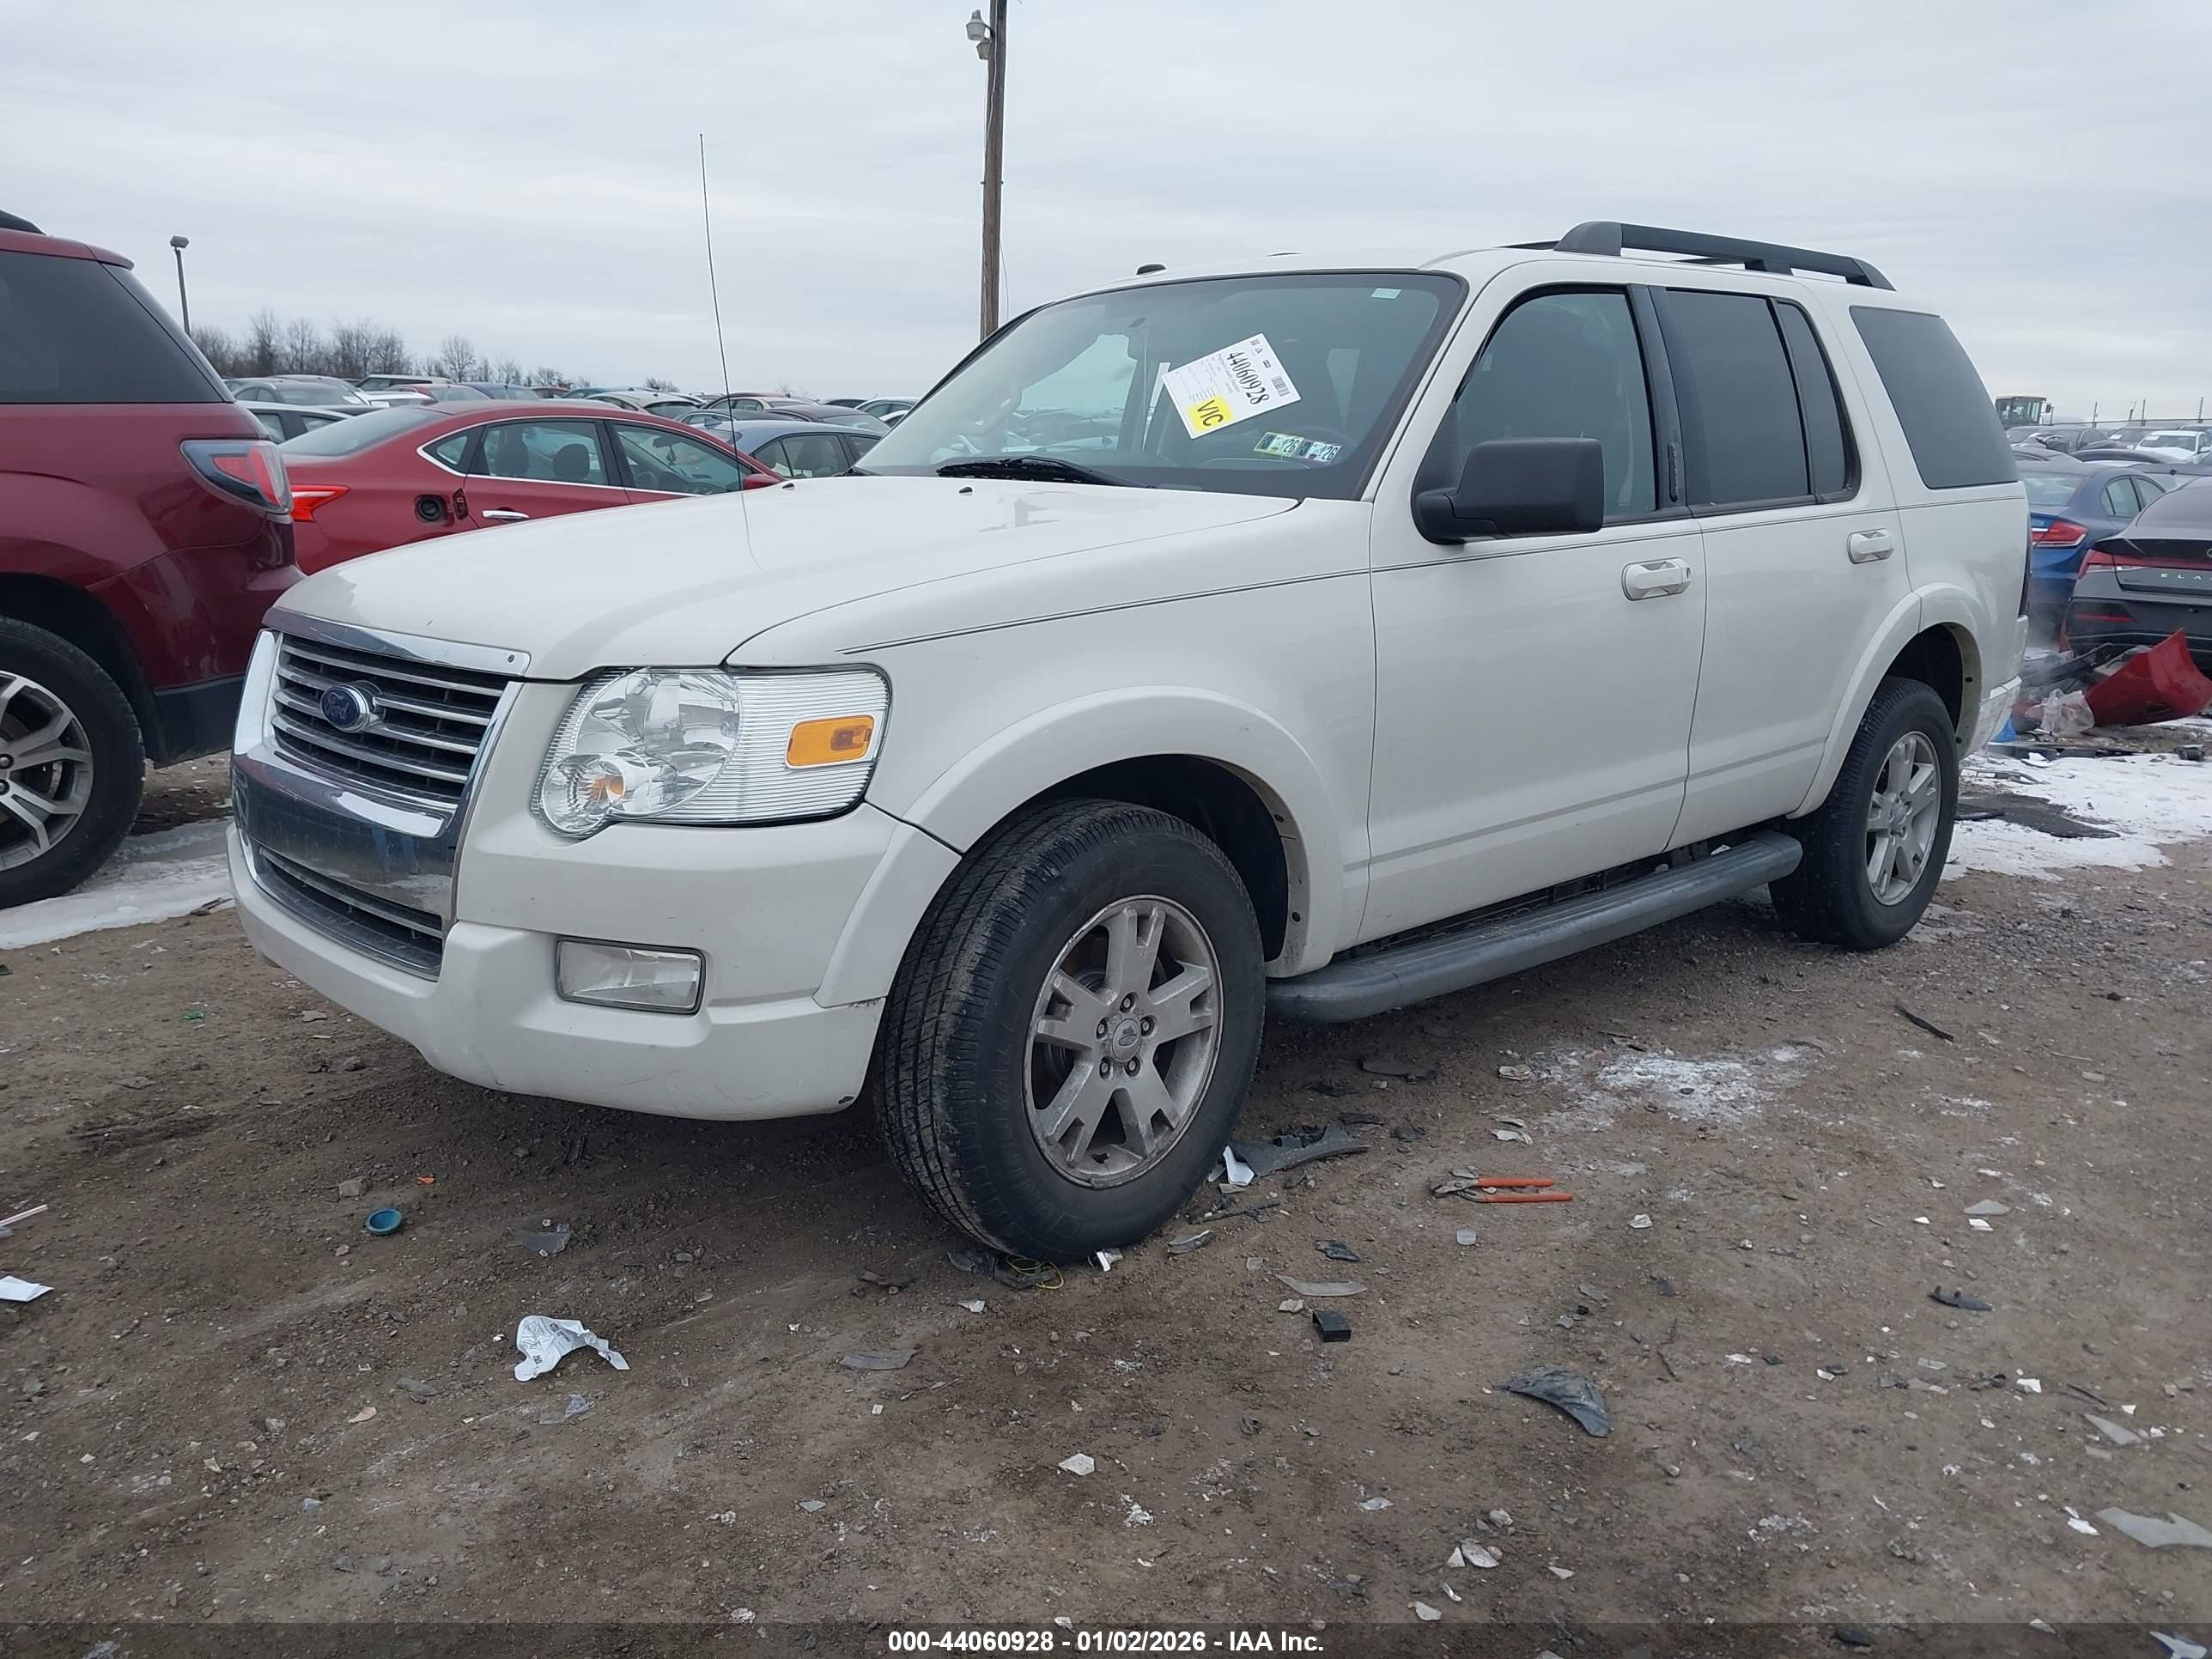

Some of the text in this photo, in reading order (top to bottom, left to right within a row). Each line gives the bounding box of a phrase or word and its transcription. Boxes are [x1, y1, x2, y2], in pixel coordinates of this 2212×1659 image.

[1226, 351, 1270, 405] 44060928
[1196, 399, 1224, 427] VIC
[325, 691, 349, 720] Ford
